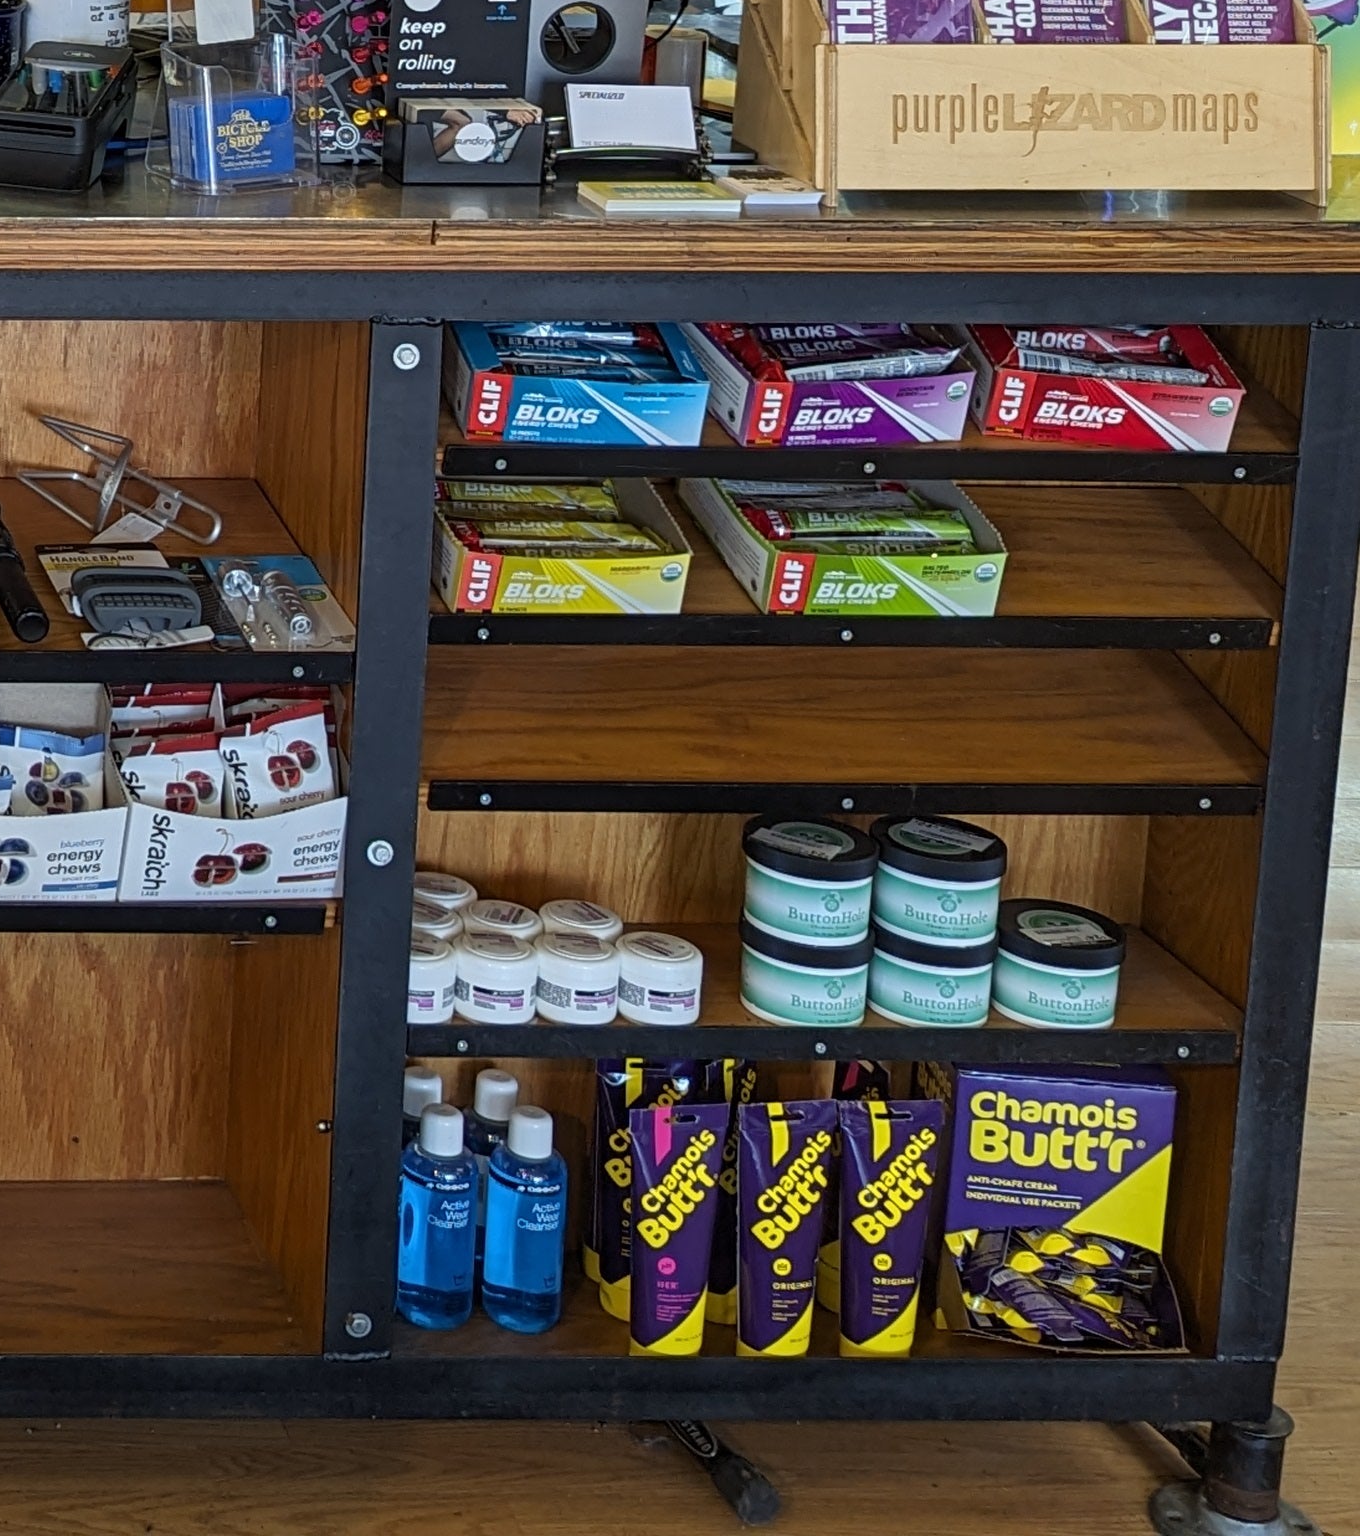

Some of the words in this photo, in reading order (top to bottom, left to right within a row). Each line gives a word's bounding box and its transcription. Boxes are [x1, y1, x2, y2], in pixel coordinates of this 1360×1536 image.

[399, 18, 446, 37] keep
[398, 38, 423, 51] on
[397, 55, 456, 75] rolling
[891, 83, 999, 144] purple
[1002, 86, 1167, 132] LIZARD
[1172, 92, 1259, 144] maps
[229, 135, 264, 148] SHOP
[476, 378, 502, 425] CLIF
[998, 376, 1026, 421] CLIF
[514, 404, 602, 424] BLOKS
[757, 388, 784, 433] CLIF
[793, 406, 876, 427] BLOKS
[1037, 400, 1127, 423] BLOKS
[49, 552, 136, 564] HANDLEBAND
[467, 559, 490, 603] CLIF
[778, 560, 800, 604] CLIF
[503, 583, 586, 600] BLOKS
[814, 583, 900, 601] BLOKS
[58, 837, 106, 850] blueberry
[47, 861, 102, 876] chews
[293, 851, 339, 868] chews
[788, 906, 866, 925] ButtonHole
[903, 903, 988, 926] ButtonHole
[970, 1091, 1138, 1131] Chamois
[969, 1119, 1136, 1174] Butt'r
[641, 1129, 716, 1214] Chamois
[756, 1129, 832, 1215] Chamois
[857, 1126, 937, 1210] Chamois
[967, 1173, 1020, 1189] ANTI-CHAFE
[1021, 1179, 1058, 1193] CREAM
[440, 1200, 470, 1211] Active
[531, 1202, 561, 1213] Active
[636, 1161, 717, 1249] Butt'r
[750, 1161, 829, 1251] Butt'r
[427, 1214, 469, 1229] Cleanser
[516, 1218, 560, 1232] Cleanser
[871, 1275, 915, 1287] ORIGINAL
